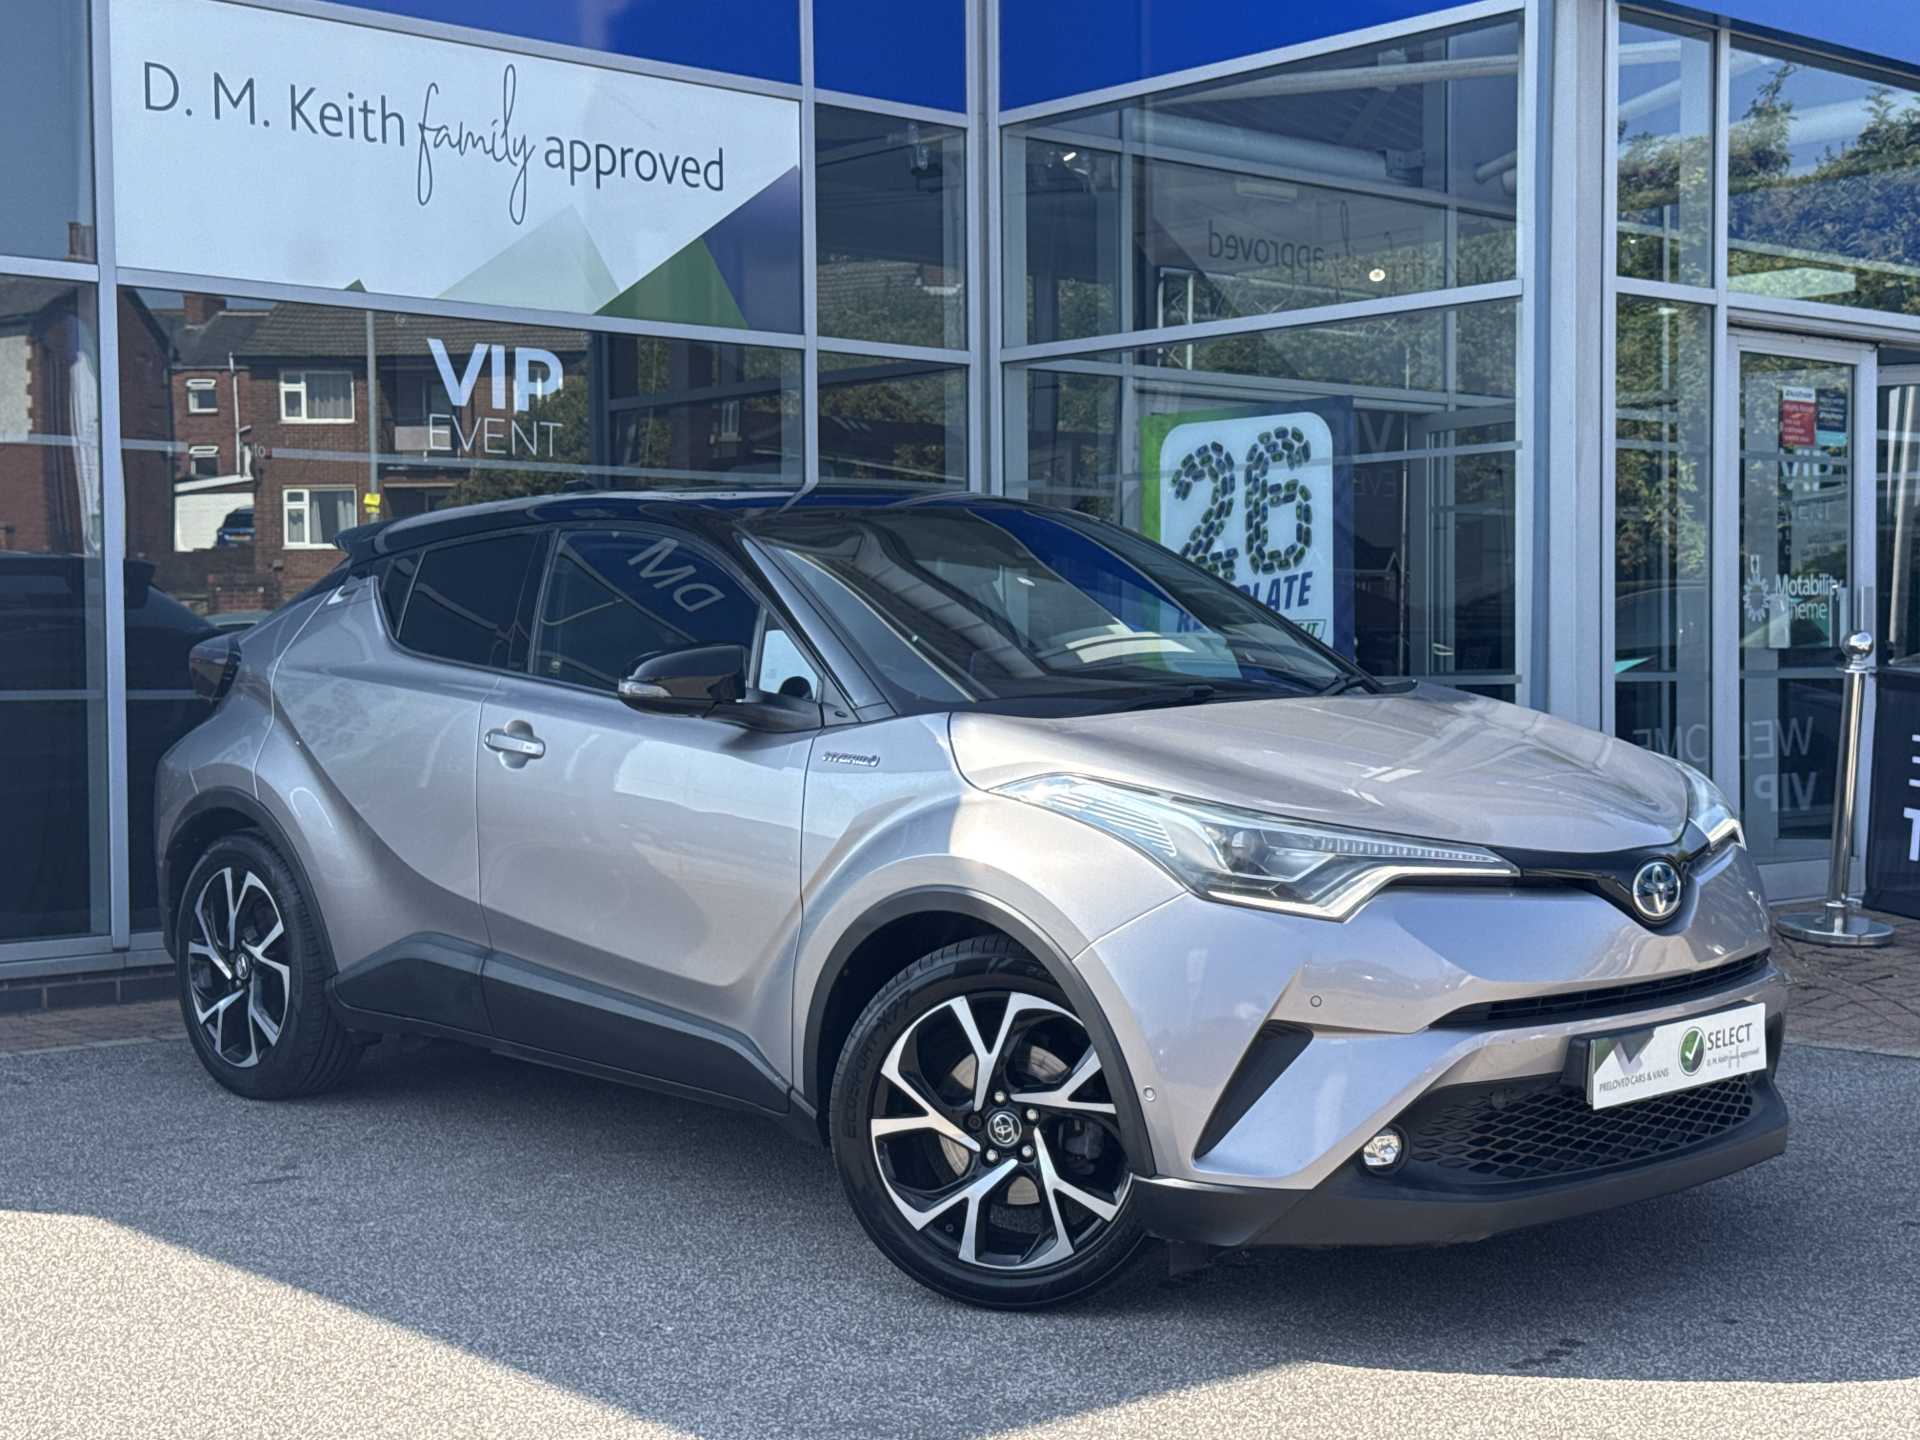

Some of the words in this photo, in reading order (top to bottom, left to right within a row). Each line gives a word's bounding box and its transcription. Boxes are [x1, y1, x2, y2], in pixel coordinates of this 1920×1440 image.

[144, 61, 193, 117] D.
[213, 71, 270, 128] M.
[290, 83, 405, 147] Keith
[417, 63, 536, 226] family
[544, 135, 724, 192] approved
[426, 337, 564, 413] VIP
[429, 413, 563, 458] EVENT
[1171, 426, 1313, 577] 26
[1775, 573, 1843, 600] Motability
[1777, 599, 1828, 620] heme
[1707, 1022, 1753, 1051] SELECT
[1630, 1072, 1646, 1085] CARS
